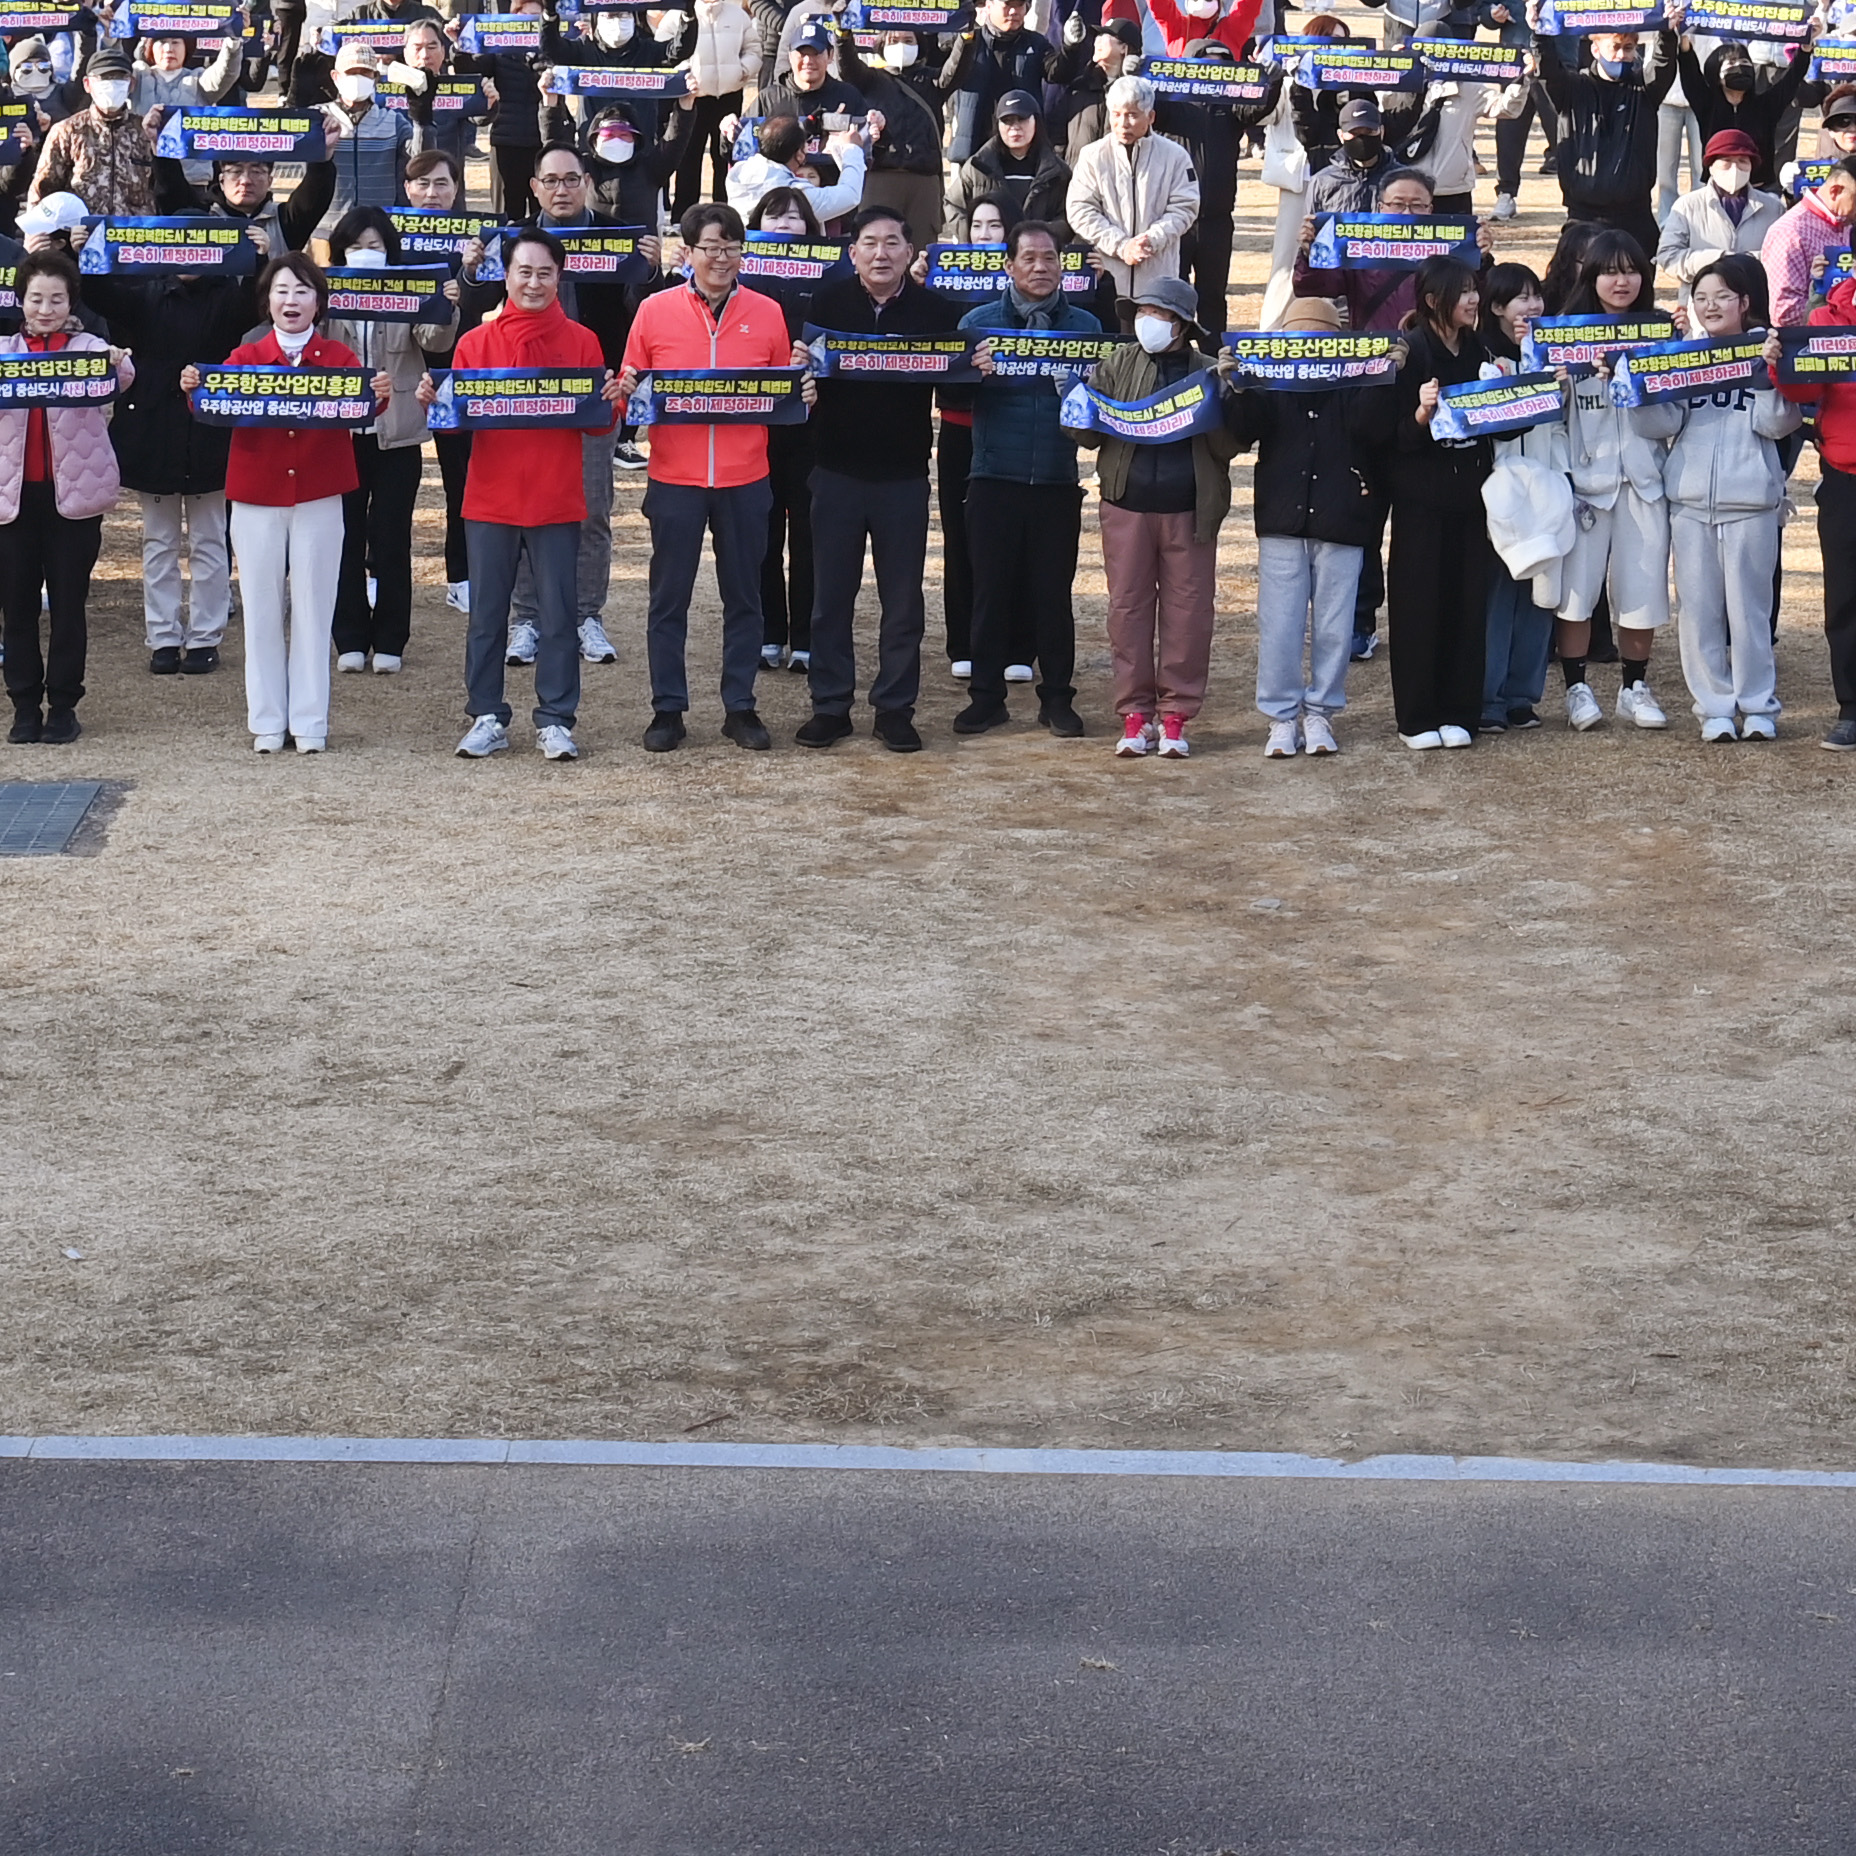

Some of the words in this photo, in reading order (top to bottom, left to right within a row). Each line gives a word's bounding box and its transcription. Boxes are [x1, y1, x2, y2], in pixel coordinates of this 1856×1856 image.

[578, 73, 612, 87] 조속히
[614, 74, 666, 89] 제정하라!!
[182, 116, 257, 131] 우주항공복합도시
[259, 118, 279, 132] 건설
[281, 118, 310, 133] 특별법
[194, 133, 233, 151] 조속히
[233, 134, 294, 151] 제정하라!!
[105, 228, 184, 243] 우주항공복합도시
[186, 229, 207, 244] 건설
[209, 229, 239, 244] 특별법
[119, 246, 159, 264] 조속히
[159, 247, 223, 263] 제정하라!!
[14, 382, 60, 397] 중심도시
[204, 373, 362, 397] 우주항공산업진흥원
[454, 379, 536, 396] 우주항공복합도시
[538, 379, 559, 394] 건설
[561, 378, 593, 393] 특별법
[652, 379, 735, 393] 우주항공복합도시
[737, 380, 759, 394] 건설
[760, 380, 792, 394] 특별법
[200, 398, 264, 415] 우주항공산업
[267, 399, 311, 416] 중심도시
[468, 398, 510, 416] 조속히
[510, 396, 576, 415] 제정하라!!
[665, 396, 708, 413] 조속히
[707, 397, 774, 412] 제정하라!!
